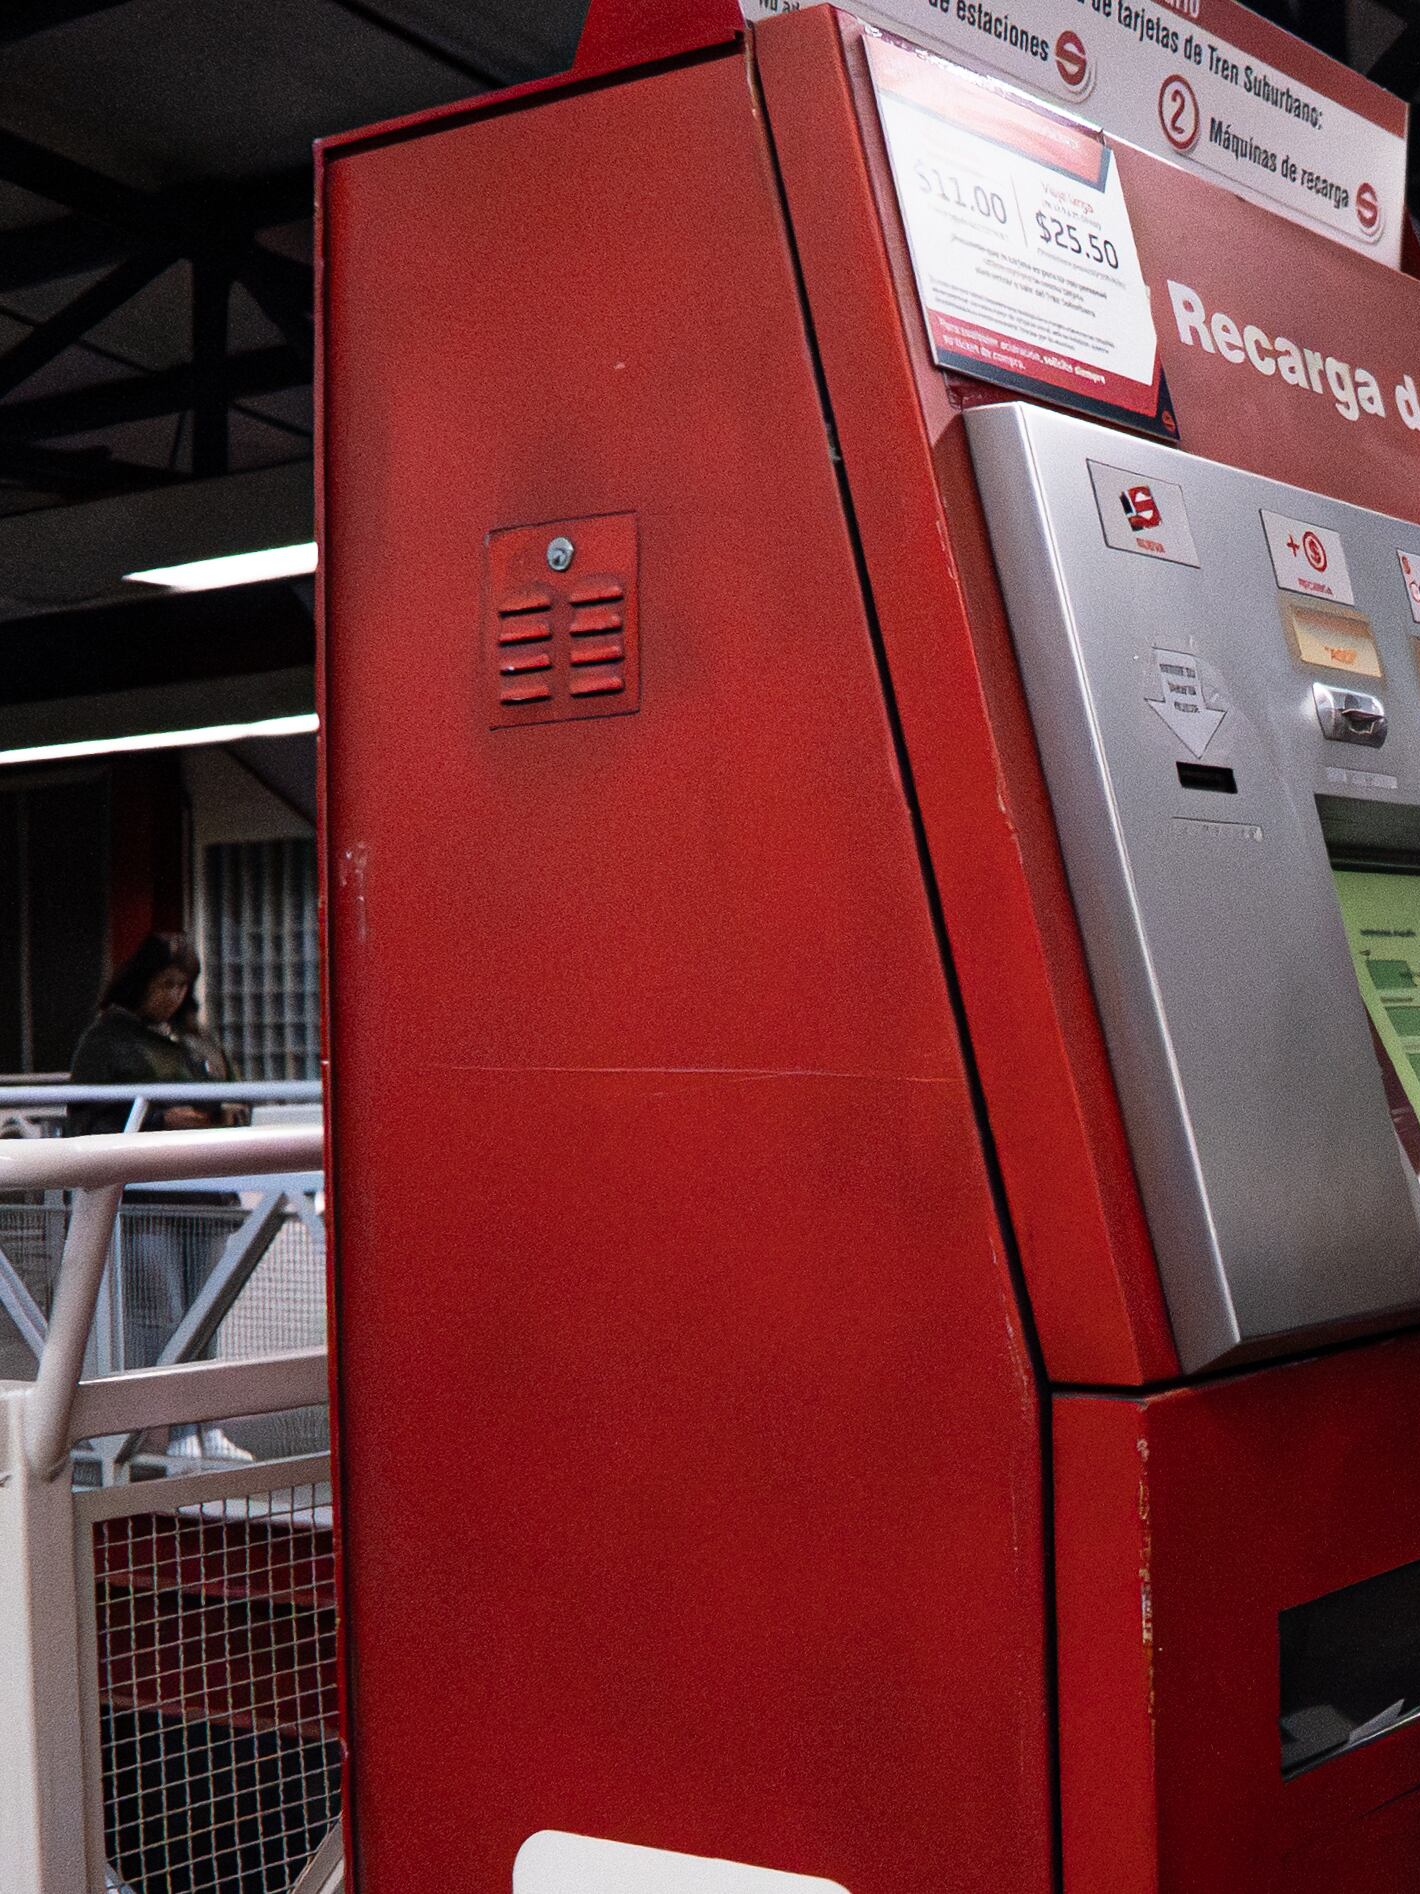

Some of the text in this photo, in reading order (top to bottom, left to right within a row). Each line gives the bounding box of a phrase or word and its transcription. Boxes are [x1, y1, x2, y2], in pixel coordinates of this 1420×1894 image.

[956, 0, 1050, 61] estaciones
[1117, 0, 1179, 53] tarjetas
[1183, 33, 1202, 66] de
[1208, 44, 1239, 86] Tren
[1243, 65, 1324, 130] Suburbano:
[913, 159, 1007, 225] $11.00
[1209, 117, 1277, 173] Máquinas
[1280, 155, 1297, 183] de
[1300, 168, 1350, 210] recarga
[1035, 210, 1118, 269] $25.50
[1166, 279, 1386, 421] Recarga
